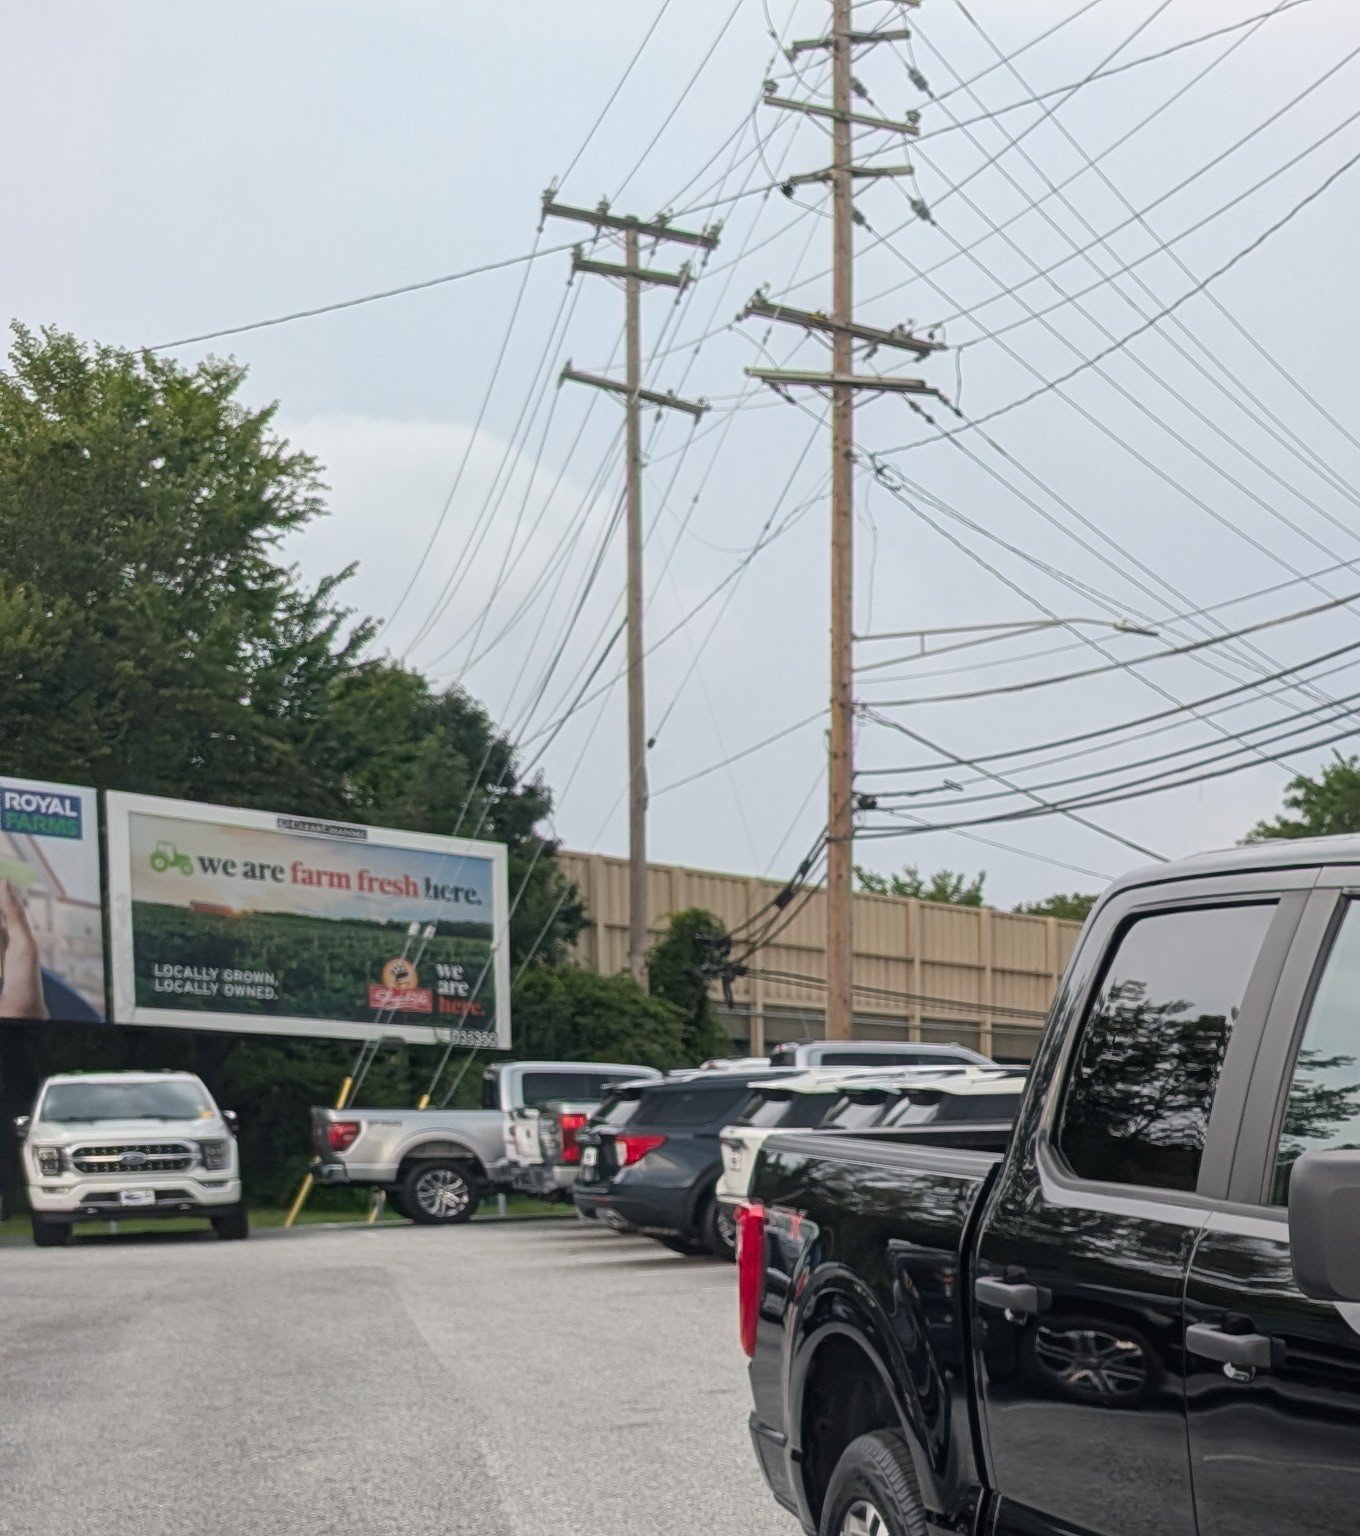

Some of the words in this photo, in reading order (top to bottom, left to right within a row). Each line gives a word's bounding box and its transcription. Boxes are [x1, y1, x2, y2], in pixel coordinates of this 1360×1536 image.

[4, 791, 78, 818] ROYAL
[198, 854, 236, 878] we
[243, 860, 285, 883] are
[291, 860, 351, 890] farm
[357, 868, 419, 898] fresh
[424, 876, 482, 905] here.
[153, 962, 219, 981] LOCALLY
[436, 963, 464, 980] we
[153, 978, 219, 996] LOCALLY
[437, 980, 470, 997] are
